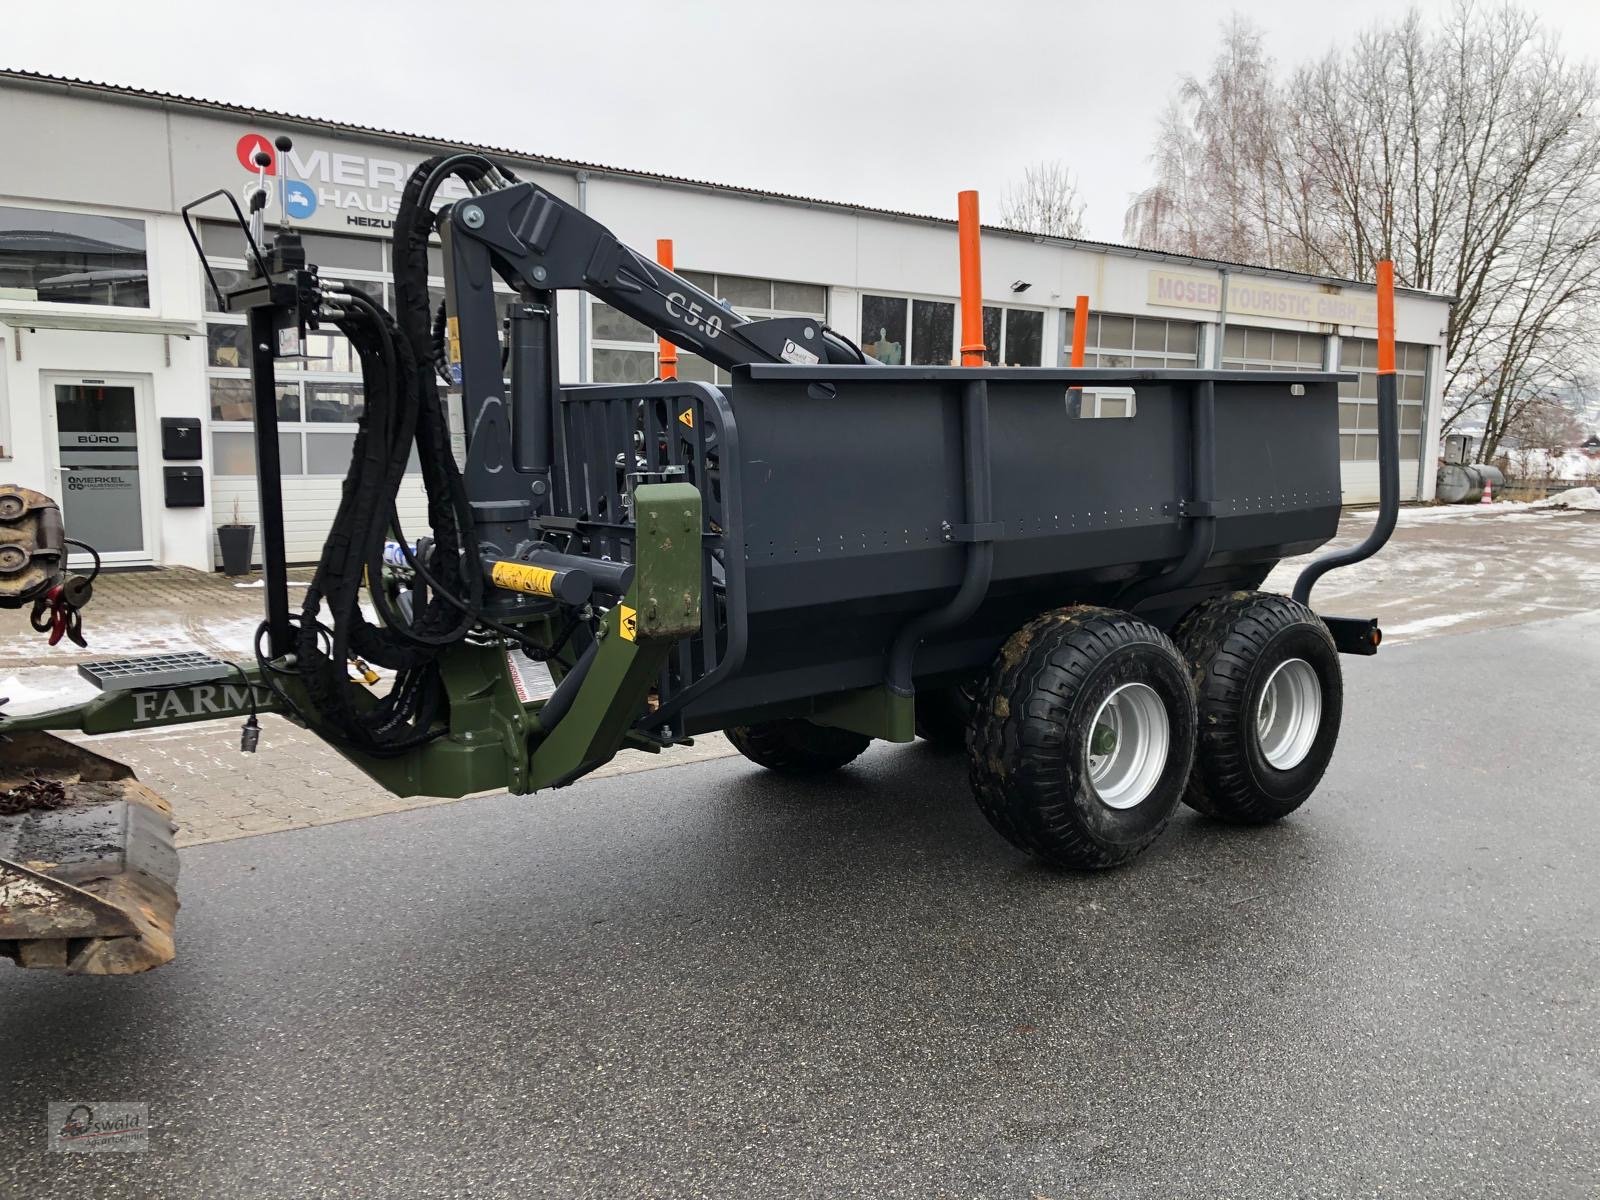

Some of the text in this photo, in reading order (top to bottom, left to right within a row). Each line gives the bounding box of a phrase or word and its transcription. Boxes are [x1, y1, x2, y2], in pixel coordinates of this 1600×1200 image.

[1157, 277, 1219, 305] MOSER
[1229, 286, 1311, 316] TOURISTIC
[665, 292, 723, 339] C5.0
[77, 434, 120, 444] BÜRO
[75, 476, 125, 484] MERKEL
